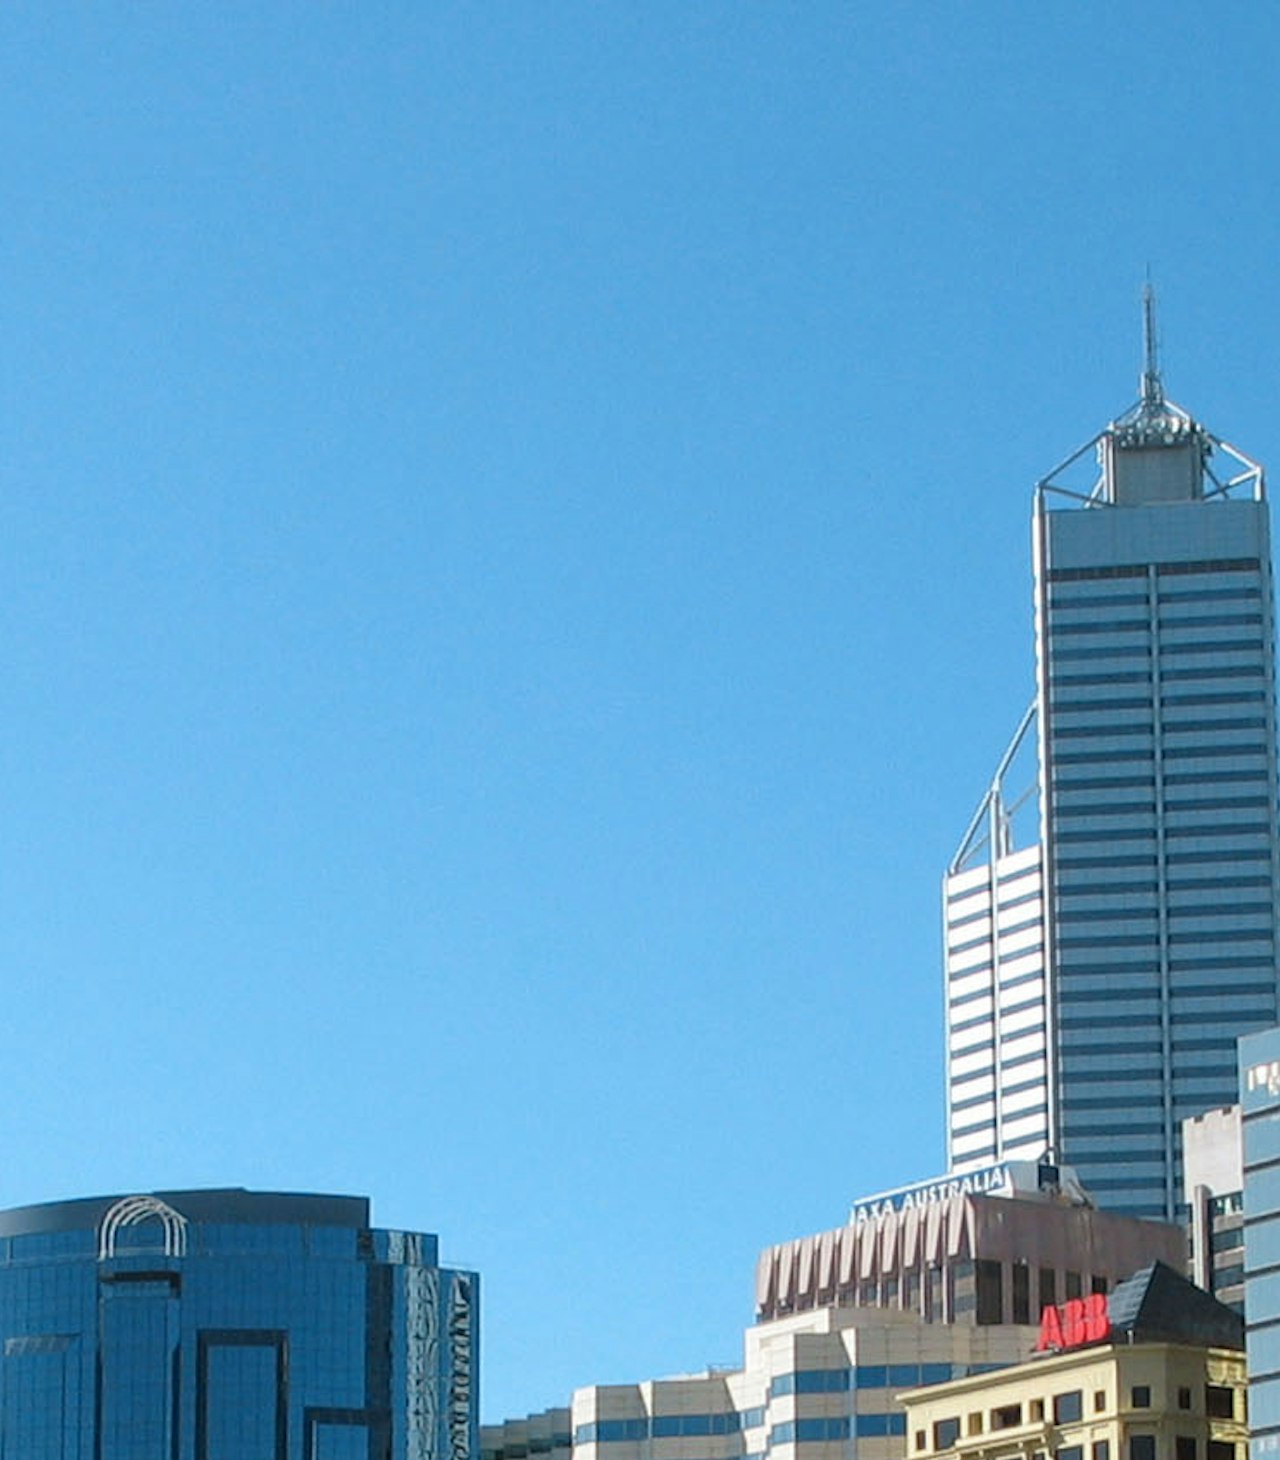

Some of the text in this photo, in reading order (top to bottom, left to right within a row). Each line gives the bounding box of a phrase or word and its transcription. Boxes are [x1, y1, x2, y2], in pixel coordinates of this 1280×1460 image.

[856, 1166, 1004, 1222] AXA AUSTRALIA
[1037, 1292, 1111, 1352] ABB
